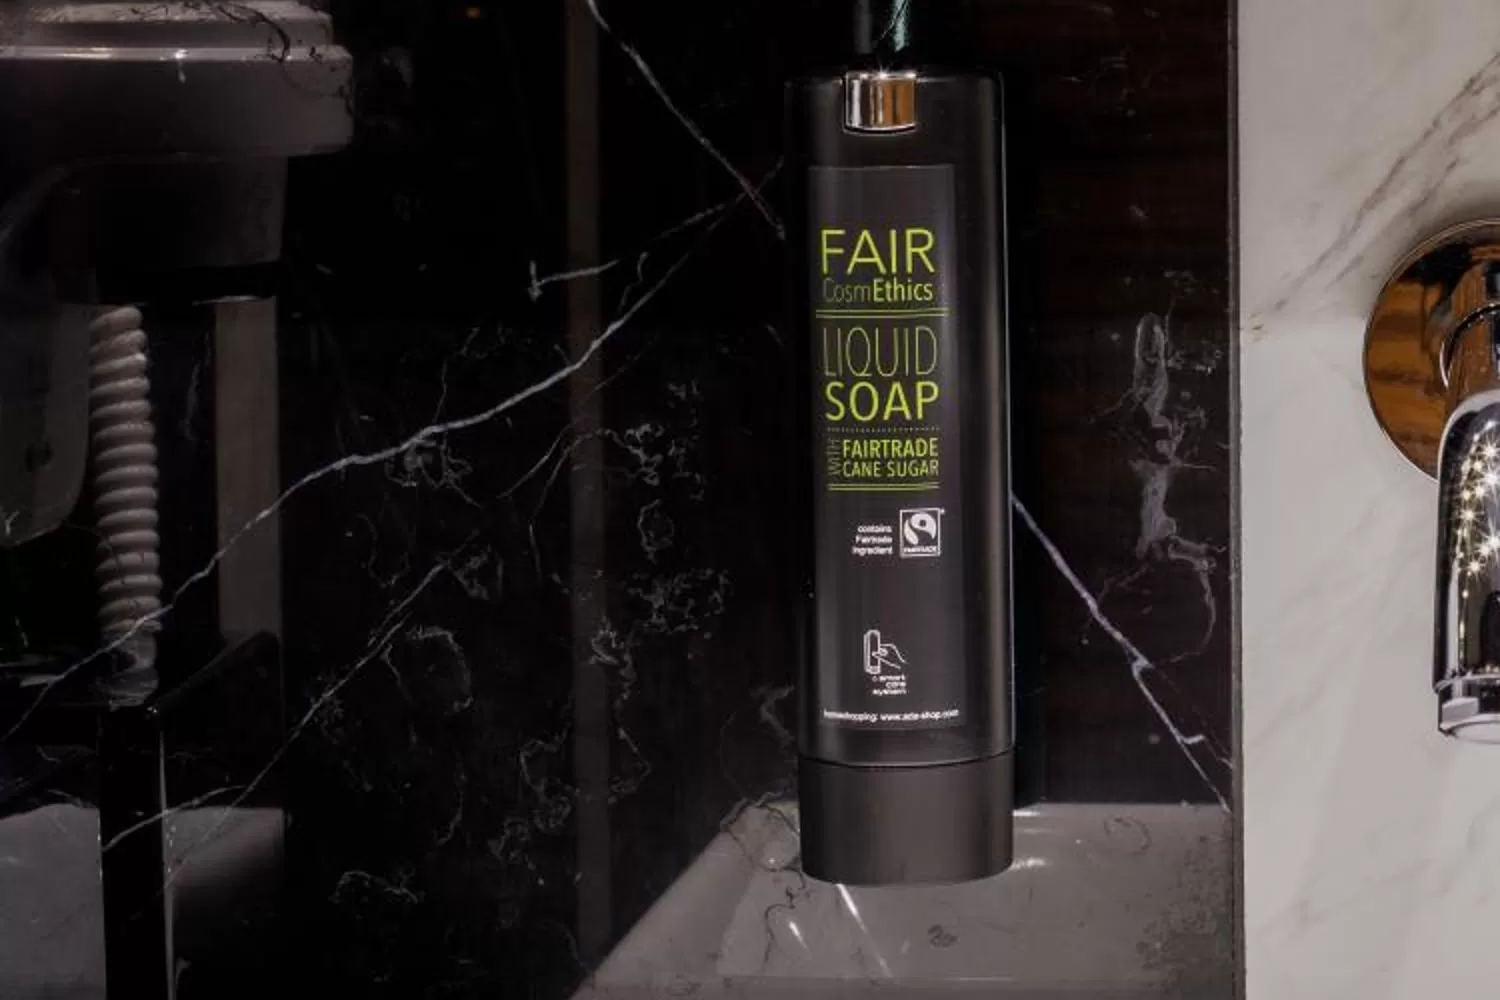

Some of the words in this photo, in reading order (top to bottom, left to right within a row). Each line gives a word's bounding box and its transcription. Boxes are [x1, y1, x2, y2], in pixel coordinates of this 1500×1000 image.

[820, 228, 935, 275] FAIR
[822, 277, 933, 302] CosmEthics
[823, 326, 938, 377] LIQUID
[825, 381, 939, 421] SOAP
[842, 437, 939, 460] FAIRTRADE
[842, 459, 881, 478] CANE
[886, 459, 940, 477] SUGAR
